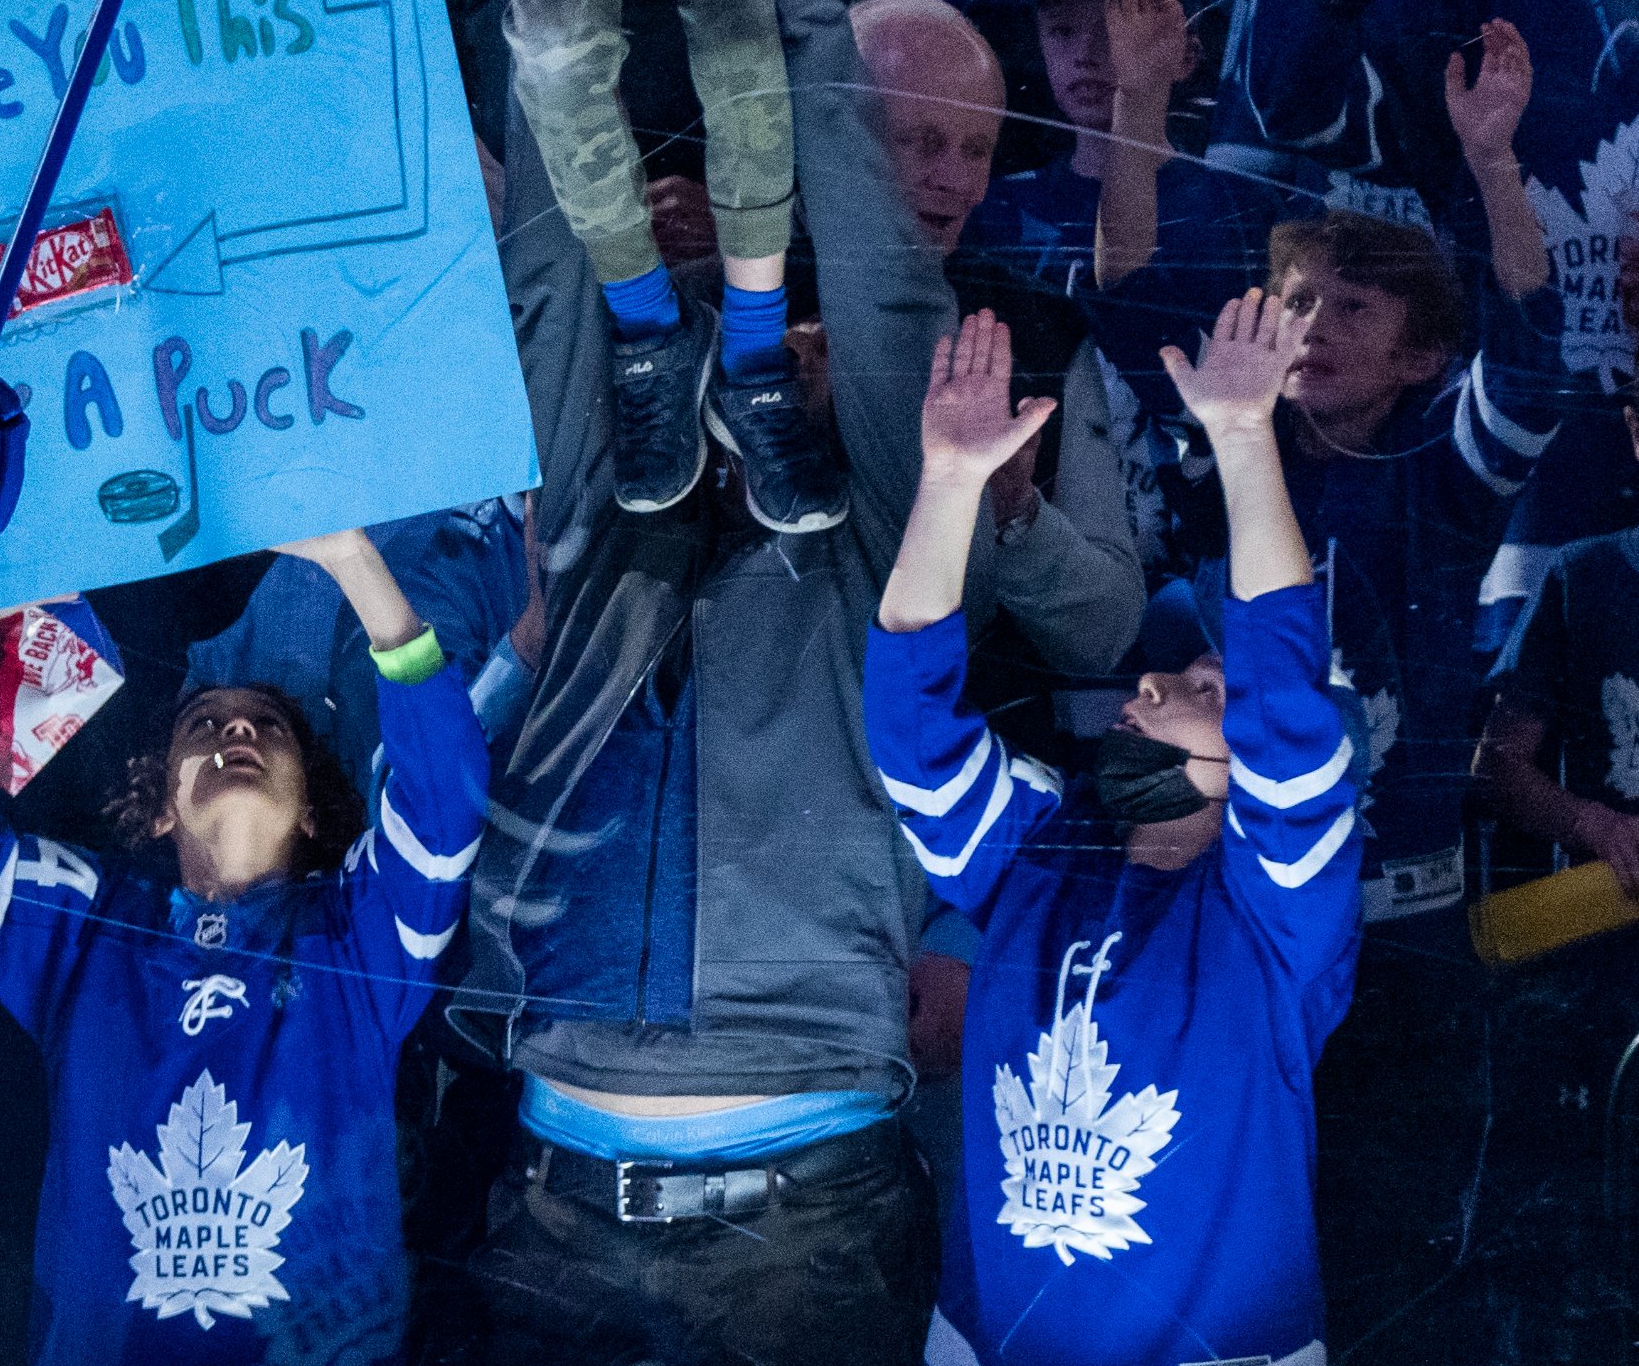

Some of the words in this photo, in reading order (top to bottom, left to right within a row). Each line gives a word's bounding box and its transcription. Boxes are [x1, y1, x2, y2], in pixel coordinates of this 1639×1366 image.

[64, 350, 123, 451] A
[1009, 1122, 1131, 1172] TORONTO
[1023, 1157, 1106, 1190] MAPLE
[135, 1186, 272, 1229] TORONTO
[1021, 1184, 1106, 1218] LEAFS
[155, 1225, 249, 1249] MAPLE
[155, 1254, 249, 1278] LEAFS
